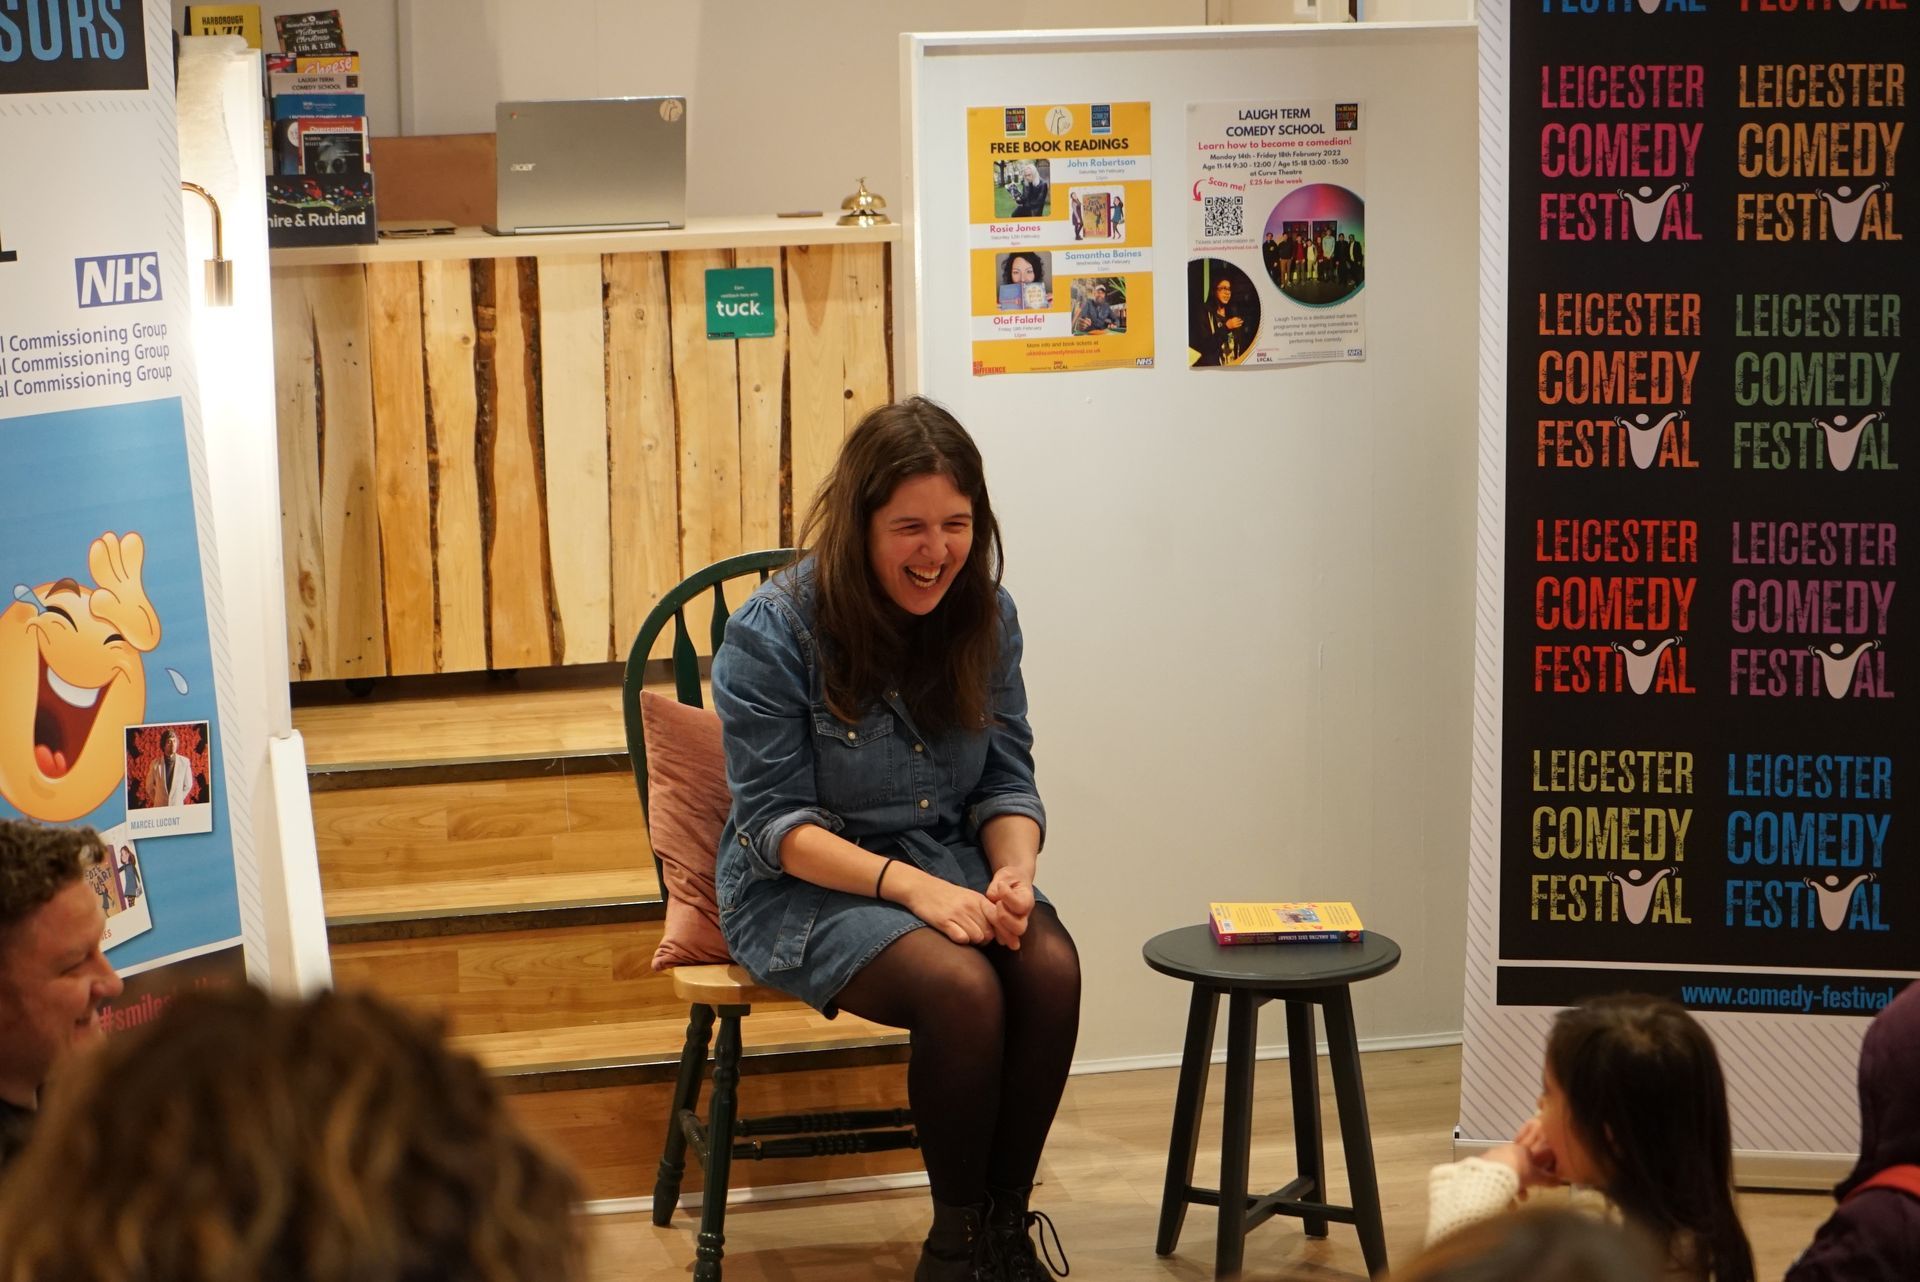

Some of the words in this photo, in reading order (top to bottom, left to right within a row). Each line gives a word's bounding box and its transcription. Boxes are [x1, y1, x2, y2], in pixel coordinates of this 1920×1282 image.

[202, 16, 243, 26] HARBOROUGH
[1541, 64, 1704, 108] LEICESTER
[1739, 63, 1905, 108] LEICESTER
[1239, 110, 1277, 120] LAUGH
[1280, 108, 1310, 118] TERM
[1199, 142, 1224, 150] Learn
[1227, 141, 1247, 149] how
[1261, 140, 1295, 148] become
[1306, 137, 1352, 146] comedian!
[1226, 126, 1275, 137] COMEDY
[1279, 124, 1325, 135] SCHOOL
[990, 142, 1019, 154] FREE
[1023, 140, 1061, 152] BOOK
[1065, 138, 1129, 150] READINGS
[1293, 150, 1322, 158] February
[1540, 122, 1704, 178] COMEDY
[1738, 122, 1904, 178] COMEDY
[1067, 160, 1088, 168] John
[1090, 158, 1136, 167] Robertson
[1208, 177, 1228, 188] Scan
[1230, 183, 1246, 192] me!
[294, 214, 306, 226] &
[308, 212, 366, 226] Rutland
[990, 225, 1014, 233] Rosie
[1015, 224, 1040, 232] Jones
[1065, 251, 1110, 260] Samantha
[1112, 250, 1142, 258] Baines
[81, 256, 158, 305] NHS
[716, 300, 764, 317] tuck.
[993, 316, 1013, 325] Olaf
[1014, 315, 1044, 324] Falafel
[1538, 292, 1701, 336] LEICESTER
[1735, 293, 1901, 338] LEICESTER
[10, 326, 127, 352] Commissioning
[132, 323, 167, 338] Group
[12, 348, 130, 374] Commissioning
[135, 344, 170, 360] Group
[1136, 358, 1152, 366] NHS
[14, 368, 132, 396] Commissioning
[137, 366, 172, 382] Group
[1537, 350, 1701, 405] COMEDY
[1734, 352, 1900, 406] COMEDY
[1535, 518, 1698, 564] LEICESTER
[1732, 521, 1897, 566] LEICESTER
[1535, 576, 1697, 630] COMEDY
[1730, 578, 1896, 634] COMEDY
[1533, 749, 1694, 794] LEICESTER
[1727, 753, 1892, 799] LEICESTER
[131, 820, 155, 830] MARCEL
[157, 817, 180, 827] LUCONT
[1532, 806, 1693, 861] COMEDY
[1726, 810, 1891, 867] COMEDY
[1682, 984, 1895, 1012] www.comedy-festival
